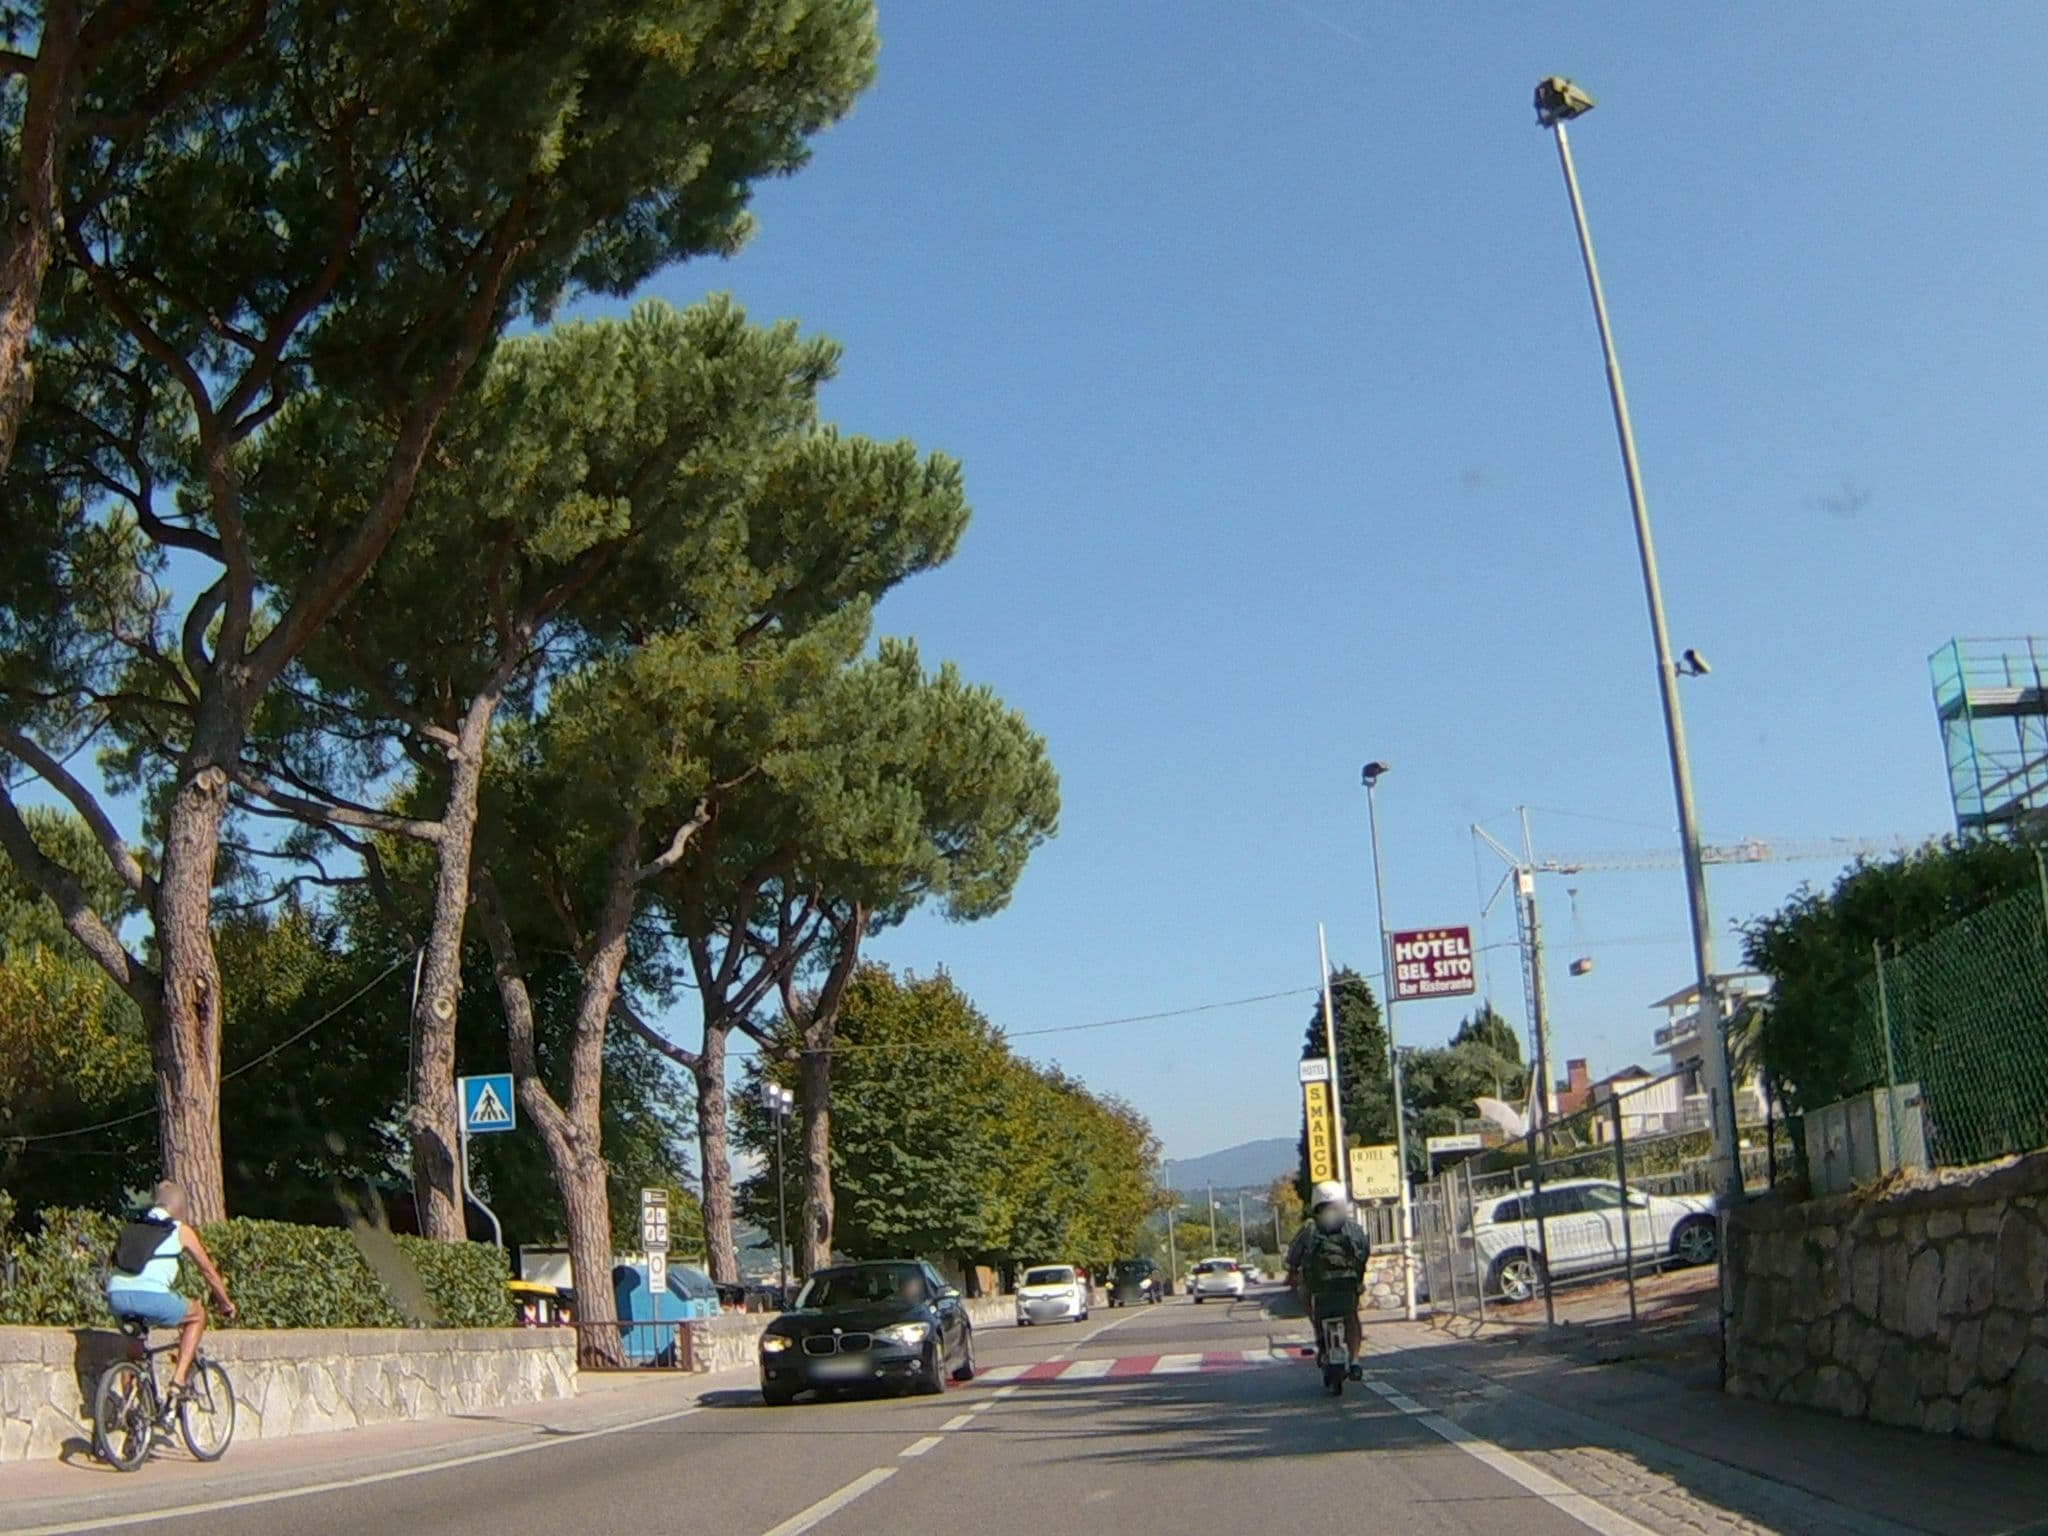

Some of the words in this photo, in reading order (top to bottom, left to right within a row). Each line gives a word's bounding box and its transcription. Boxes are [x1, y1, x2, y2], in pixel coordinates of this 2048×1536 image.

[1395, 938, 1469, 962] HOTEL
[1397, 962, 1430, 981] BEL
[1433, 958, 1472, 978] SITO
[1399, 982, 1417, 995] Bar
[1419, 977, 1473, 993] Ristorante
